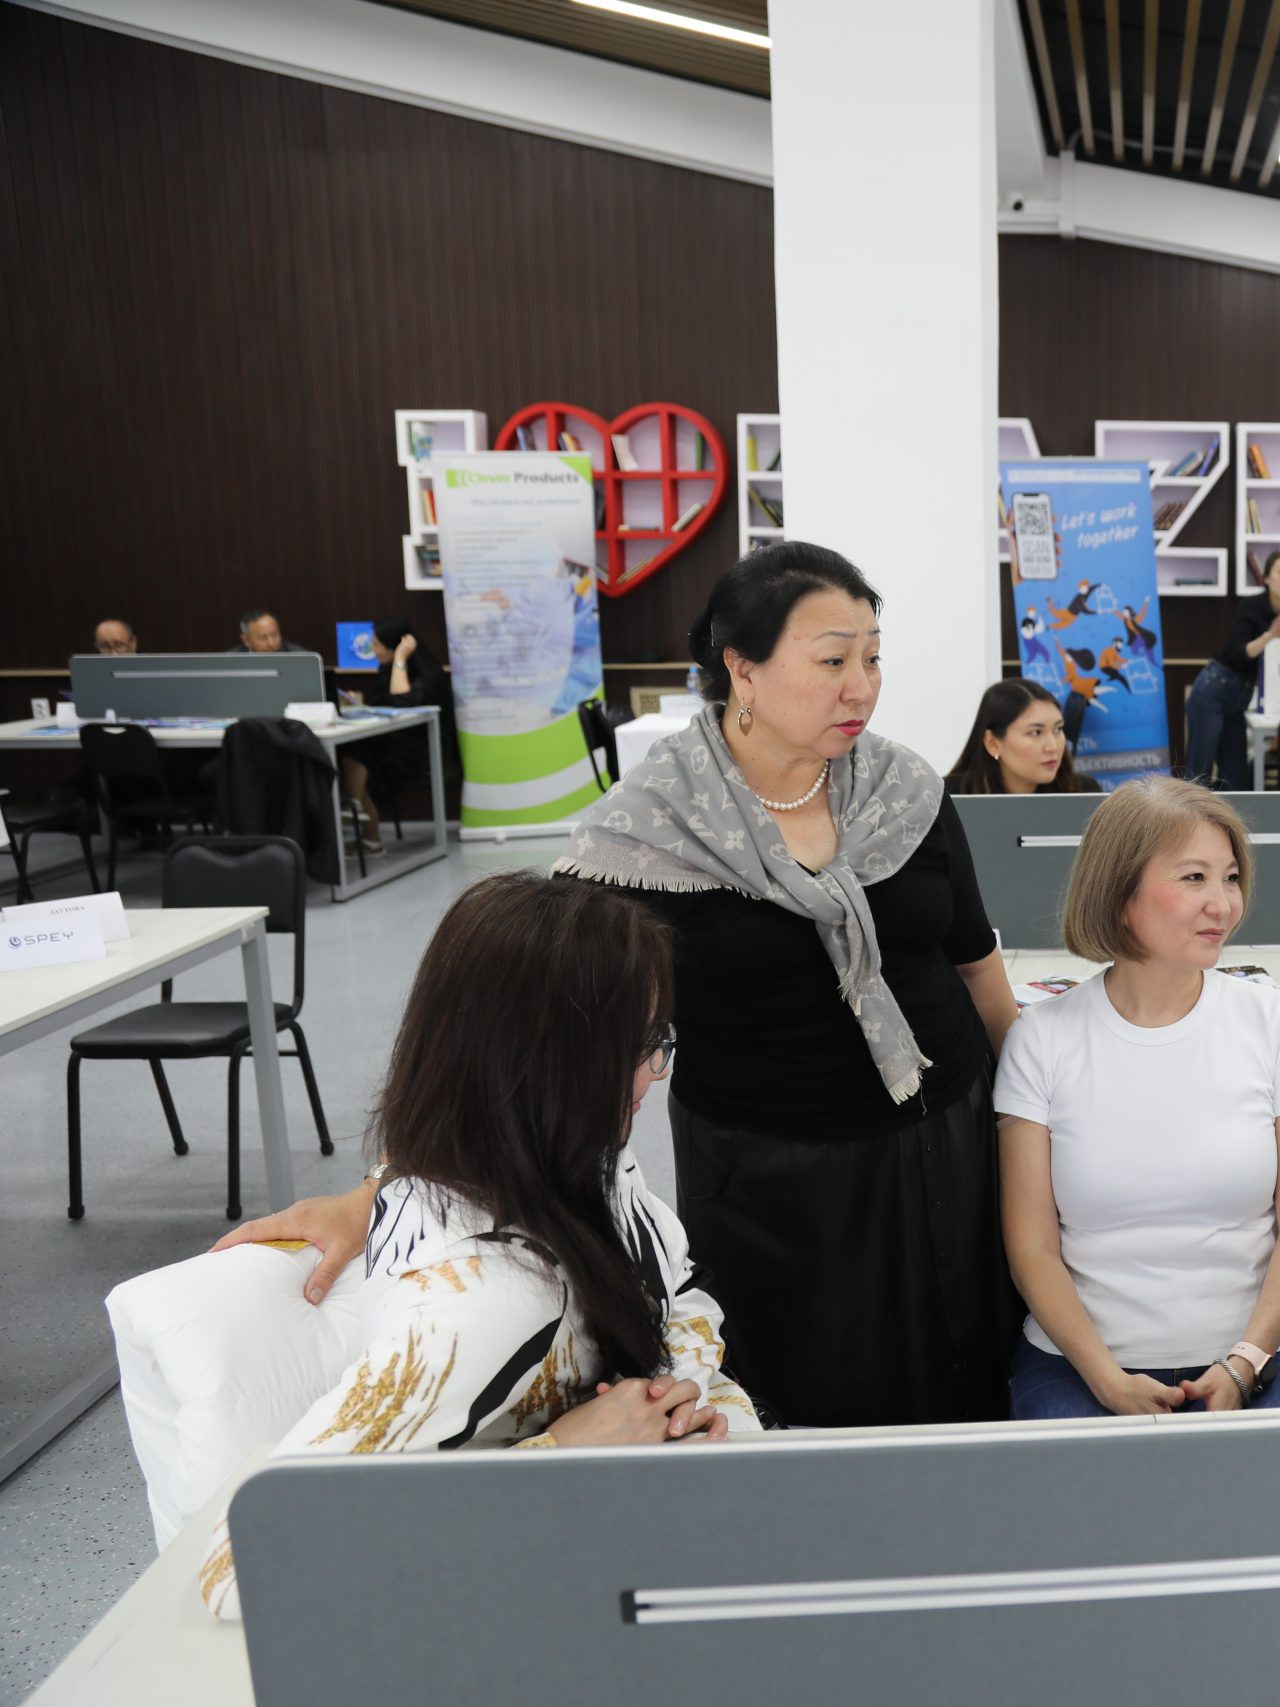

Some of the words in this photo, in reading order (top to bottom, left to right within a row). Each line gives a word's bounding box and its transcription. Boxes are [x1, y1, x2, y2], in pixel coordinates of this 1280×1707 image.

[513, 470, 580, 485] Products
[1061, 511, 1096, 531] Let's
[1101, 501, 1137, 524] work
[1077, 525, 1139, 550] together
[23, 931, 74, 945] SPEY
